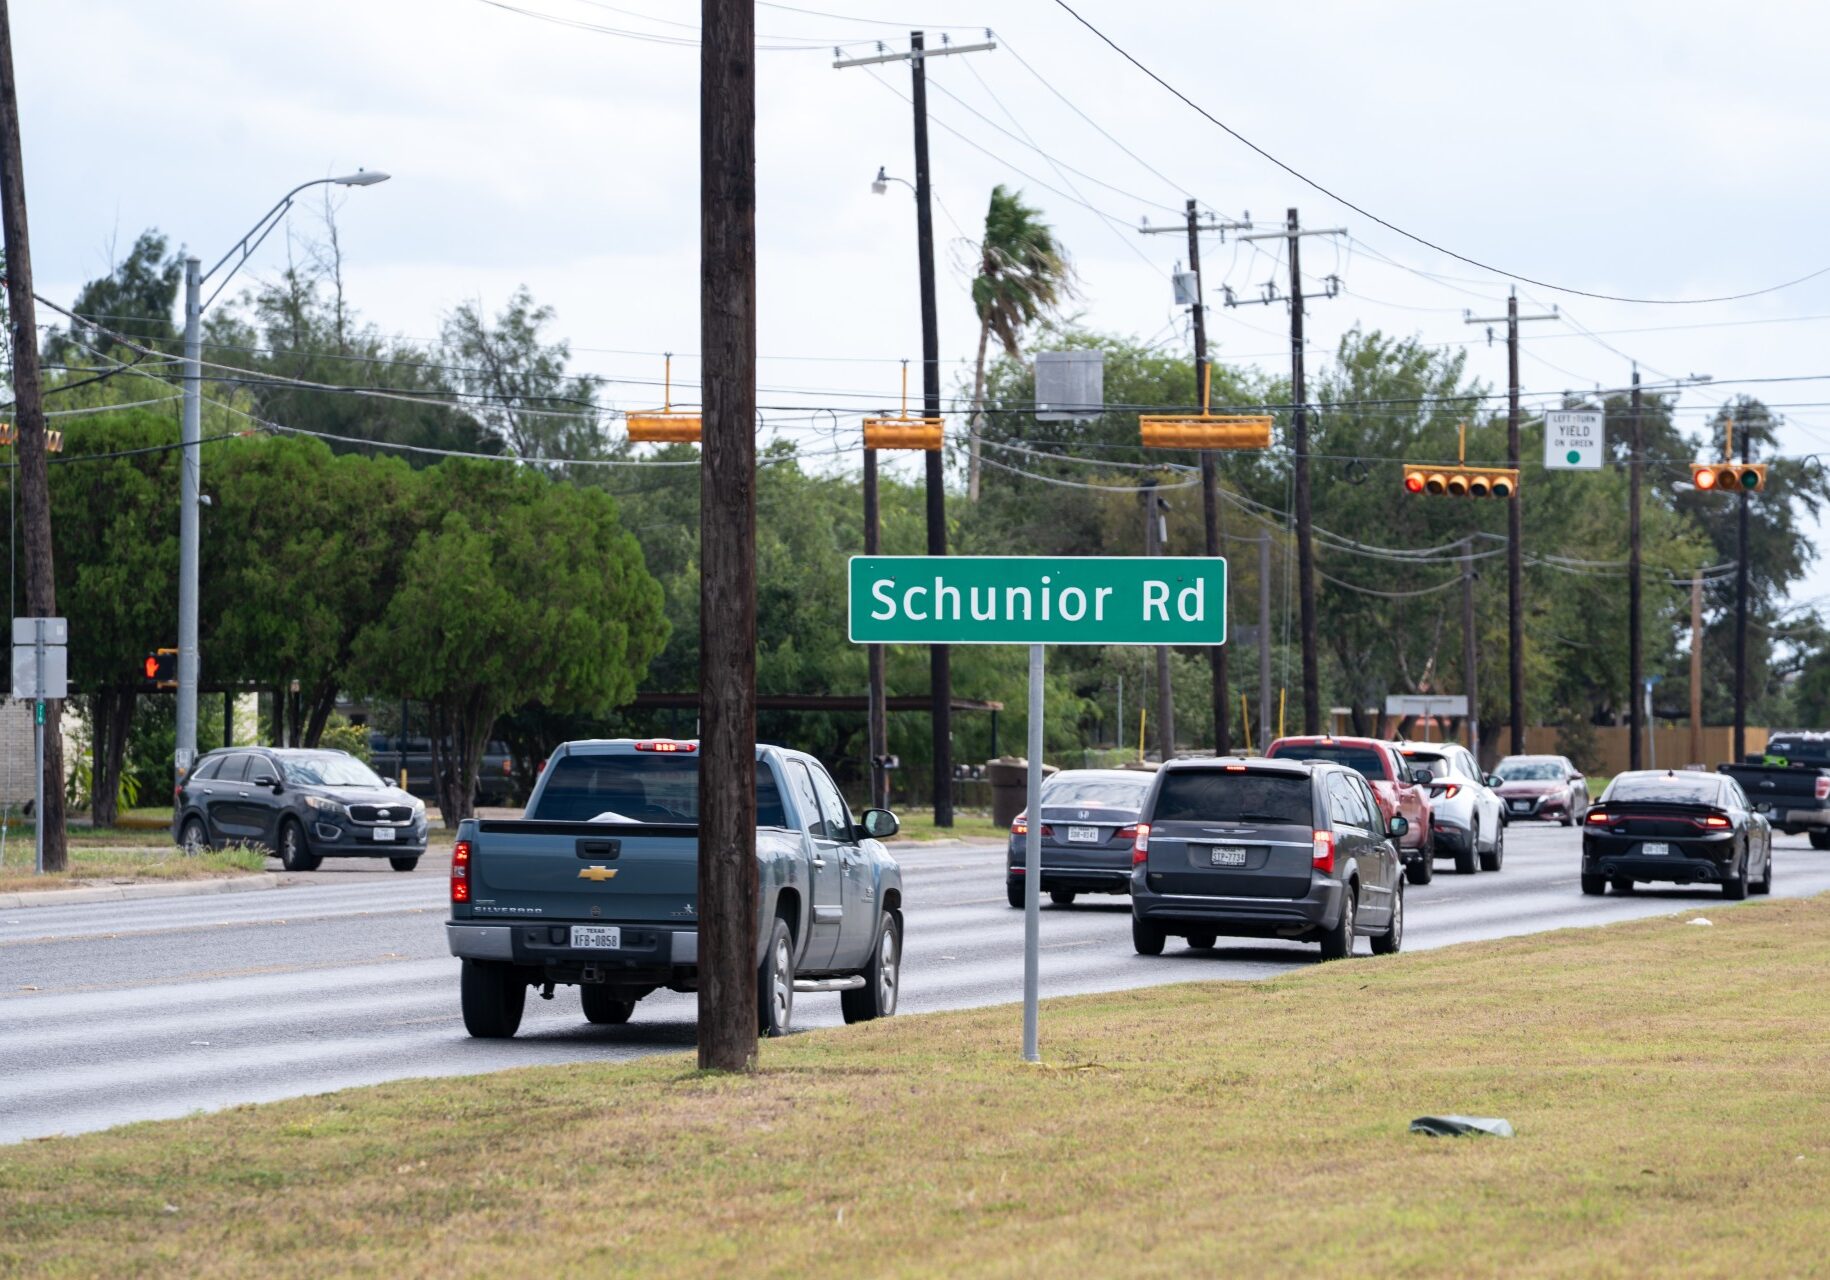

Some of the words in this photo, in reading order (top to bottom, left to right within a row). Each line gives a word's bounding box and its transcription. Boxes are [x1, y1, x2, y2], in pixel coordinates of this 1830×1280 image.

[1553, 414, 1570, 422] LEFT
[1575, 414, 1596, 422] TURN
[1559, 425, 1590, 437] YIELD
[1554, 439, 1565, 447] ON
[1570, 439, 1594, 447] GREEN
[870, 576, 1113, 621] Schunior
[1142, 577, 1205, 622] Rd
[474, 906, 543, 914] SILVERADO
